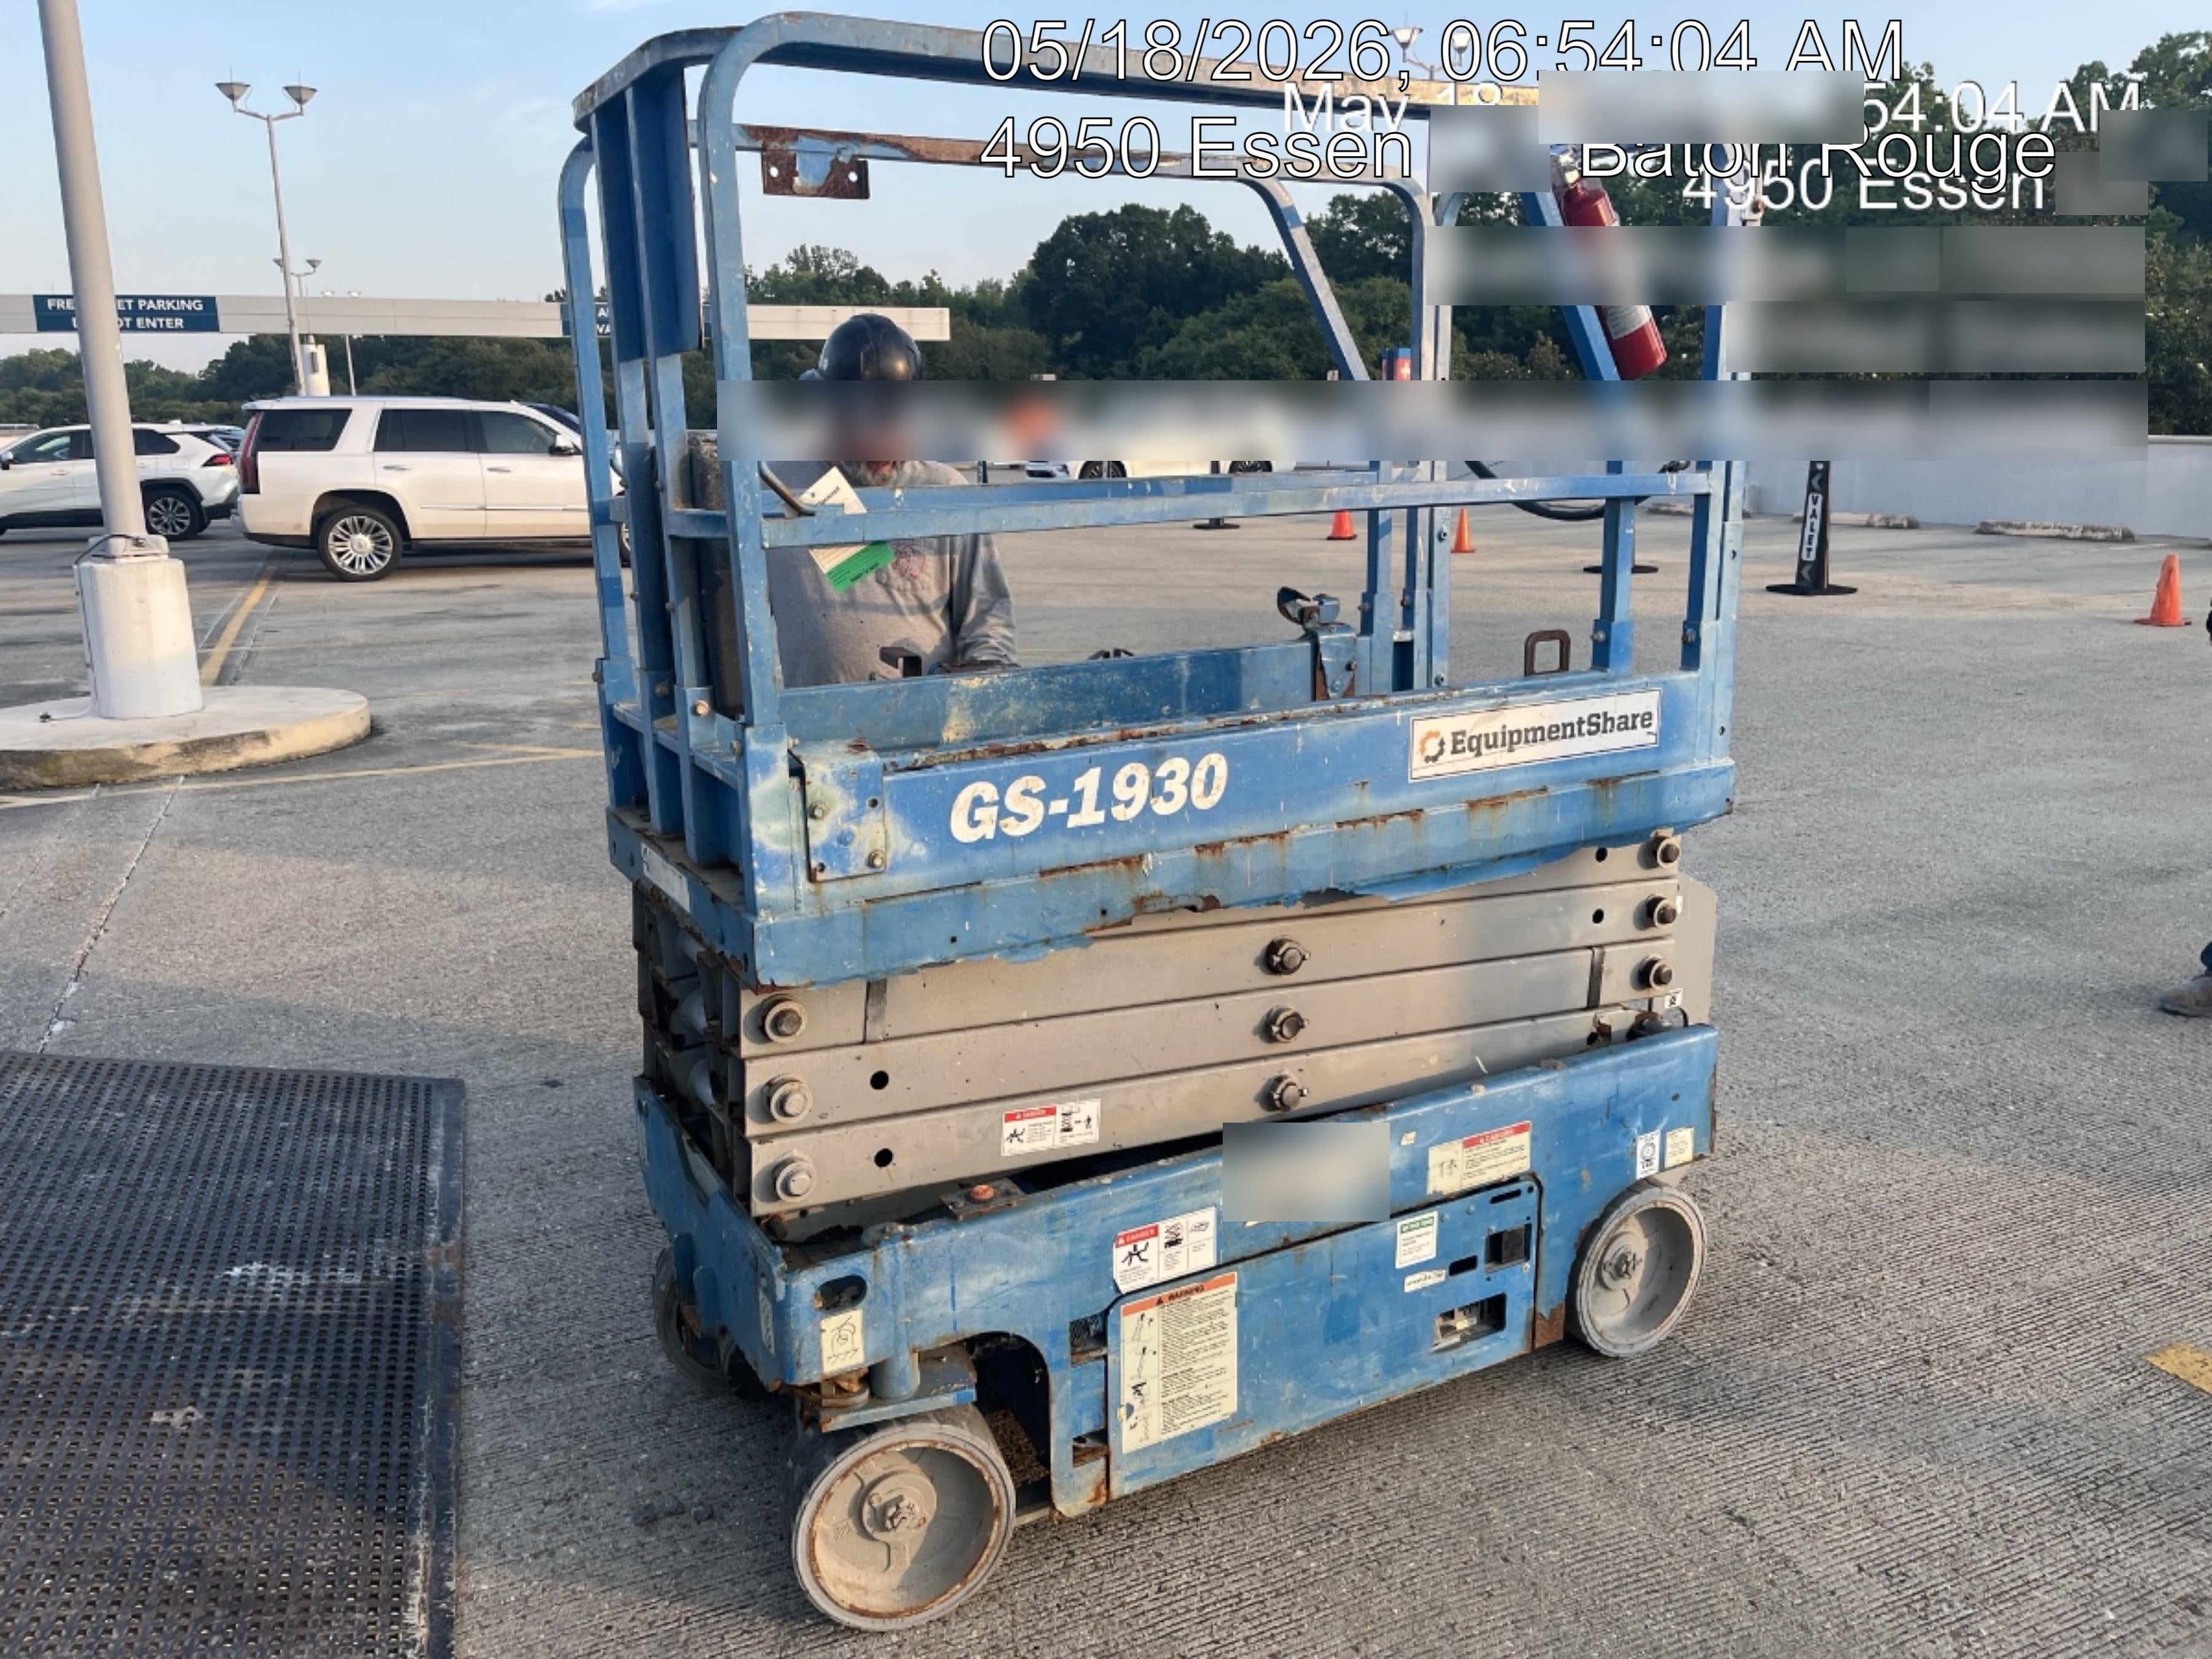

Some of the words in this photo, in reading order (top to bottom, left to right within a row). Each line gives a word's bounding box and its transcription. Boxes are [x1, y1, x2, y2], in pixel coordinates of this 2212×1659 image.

[47, 298, 76, 310] FRE
[137, 298, 203, 311] PARKING
[136, 316, 184, 329] ENTER
[1806, 495, 1820, 559] VALET
[1450, 710, 1653, 757] EquipmentShare
[950, 753, 1228, 843] GS-1930
